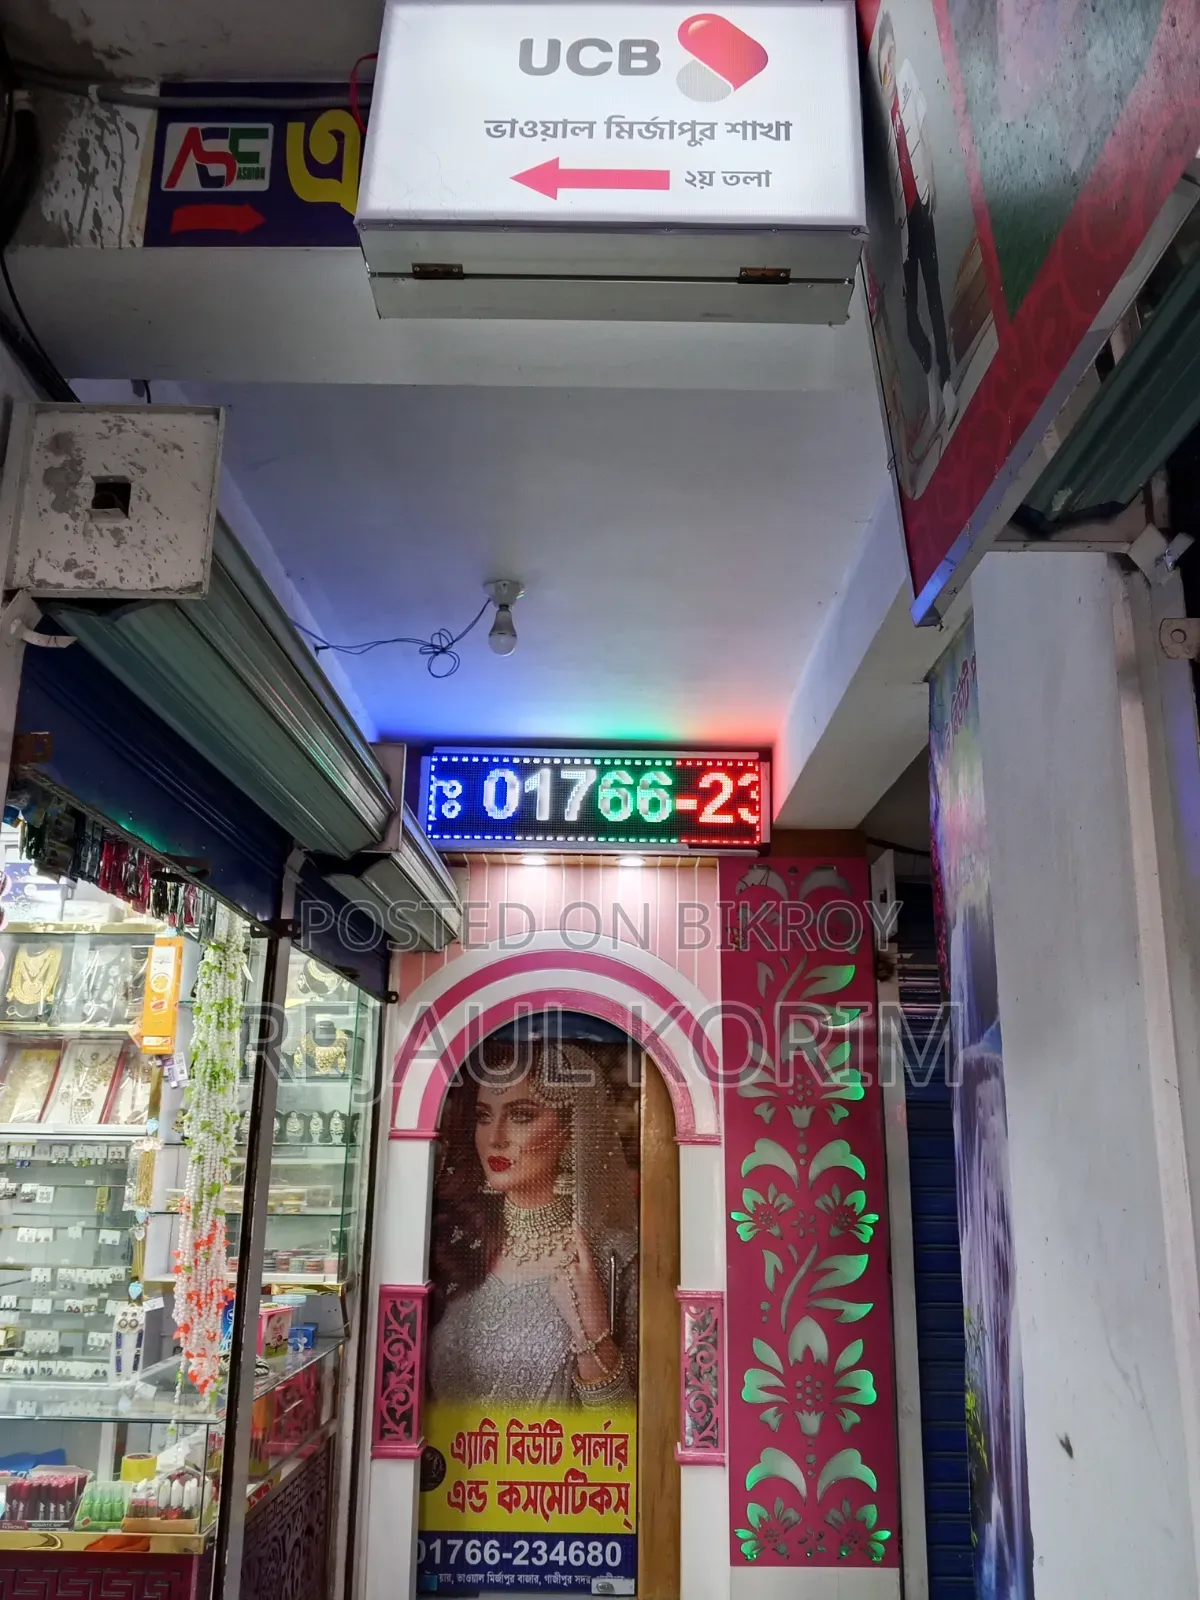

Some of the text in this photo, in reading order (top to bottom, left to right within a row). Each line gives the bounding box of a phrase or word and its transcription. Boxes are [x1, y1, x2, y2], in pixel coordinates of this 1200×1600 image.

[519, 37, 661, 77] UCB
[484, 115, 793, 147] ভাওয়াল মির্জাপুর শাখা
[685, 169, 773, 190] ২য় তলা
[506, 1418, 564, 1466] বিউটি
[570, 1420, 630, 1473] পার্লার
[447, 1480, 489, 1514] এন্ড
